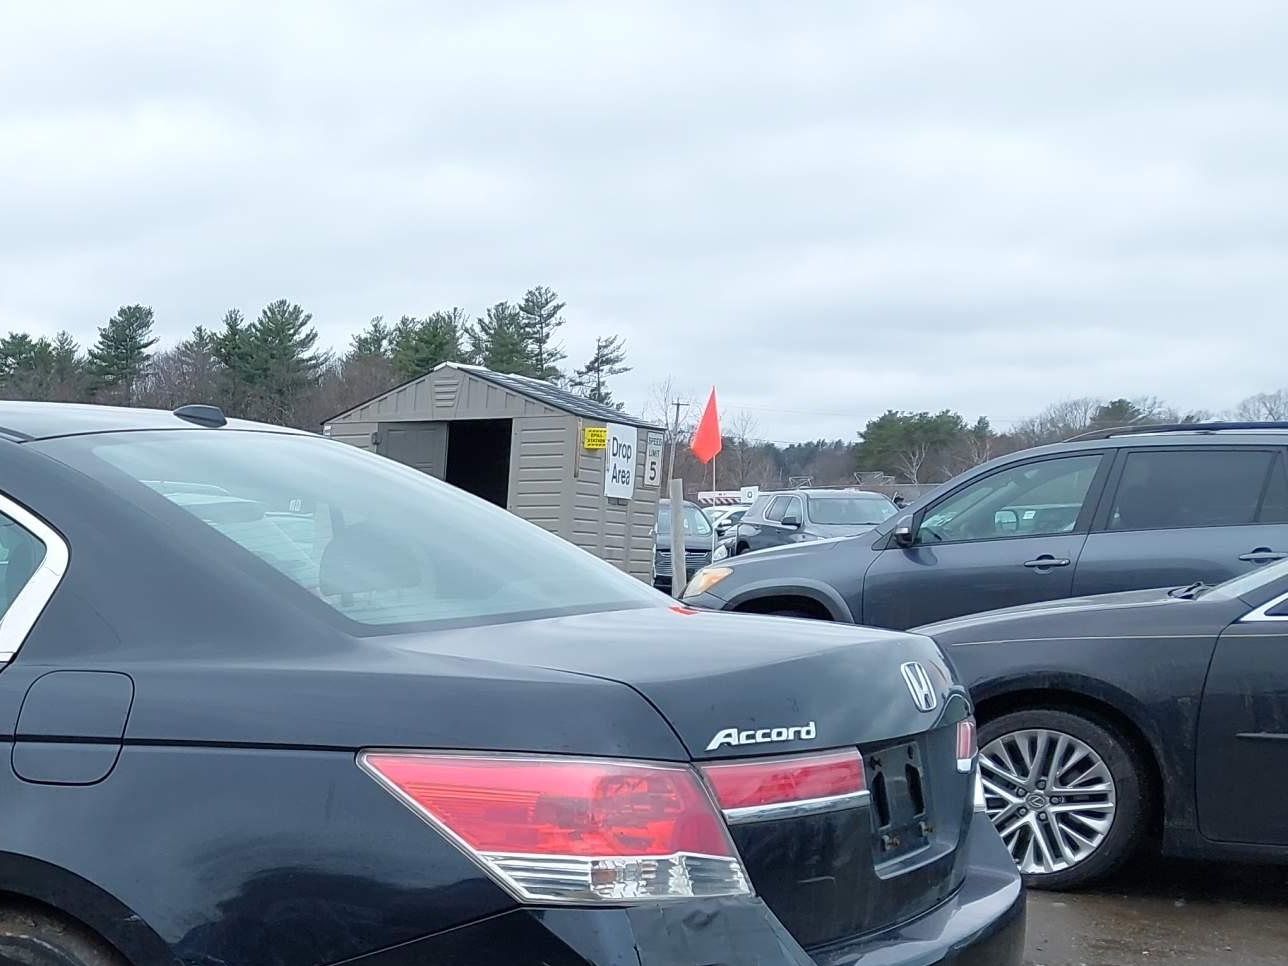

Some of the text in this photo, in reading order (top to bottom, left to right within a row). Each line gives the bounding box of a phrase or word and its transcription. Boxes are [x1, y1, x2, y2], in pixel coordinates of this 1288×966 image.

[612, 436, 632, 464] Drop
[648, 436, 663, 447] SPEED
[648, 449, 660, 457] LIMIT
[611, 463, 631, 485] Area
[649, 461, 657, 481] 5
[705, 721, 817, 751] Accord
